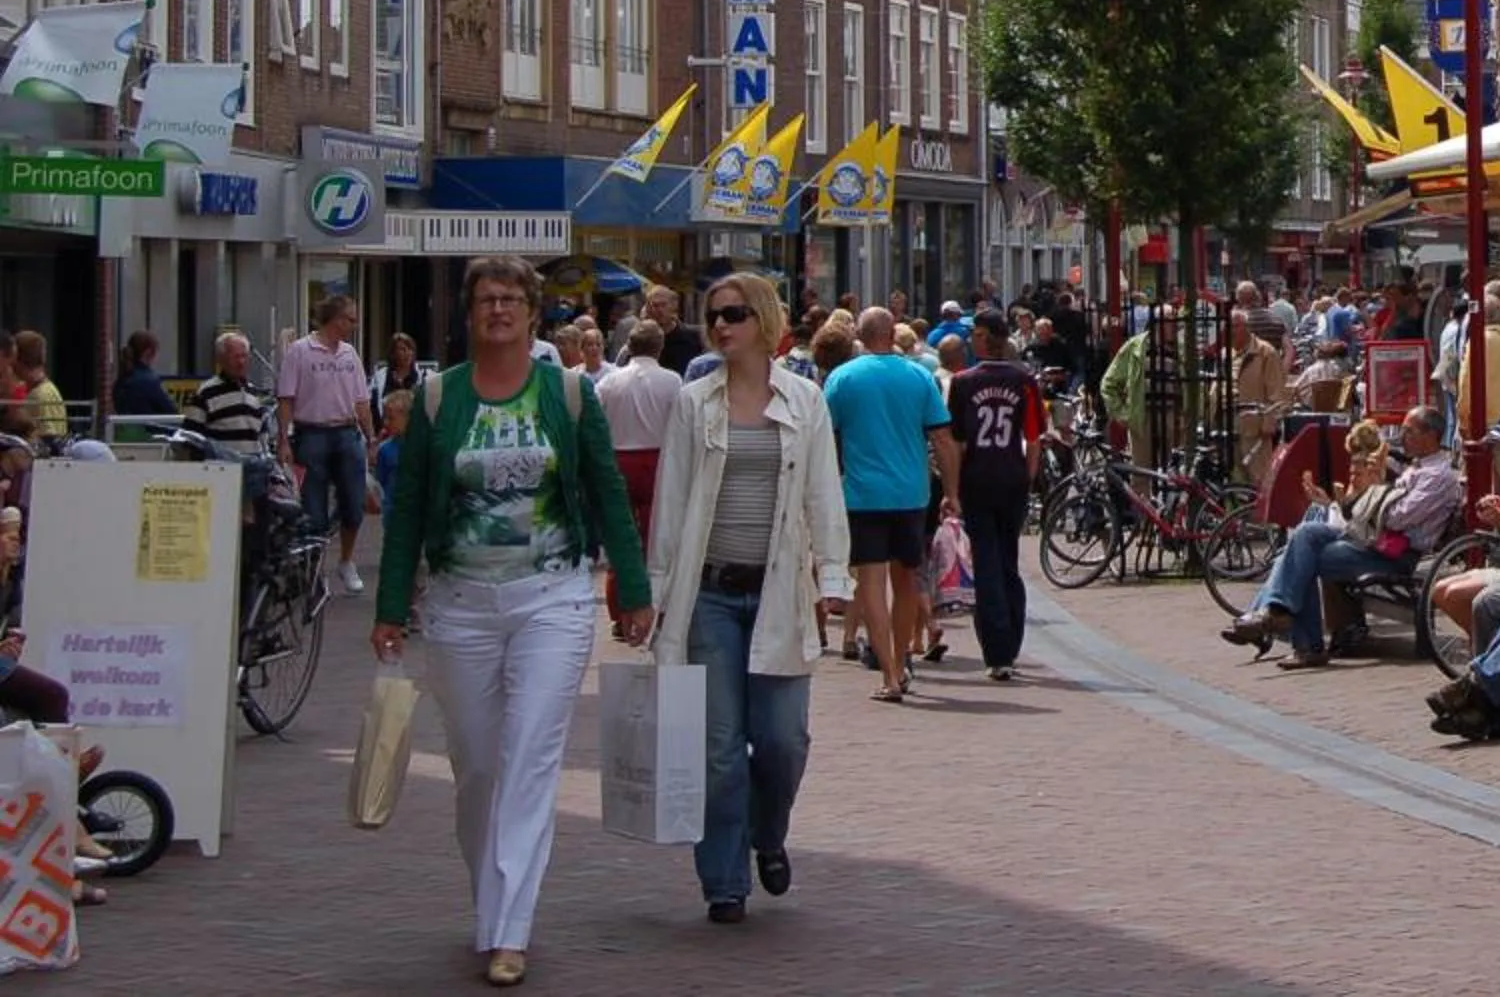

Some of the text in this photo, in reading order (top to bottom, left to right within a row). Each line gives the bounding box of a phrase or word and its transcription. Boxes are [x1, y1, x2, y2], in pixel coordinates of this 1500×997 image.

[11, 161, 154, 191] Primafoon
[976, 405, 1015, 448] 25
[62, 633, 166, 658] Hartelijk
[81, 697, 173, 717] de kerk
